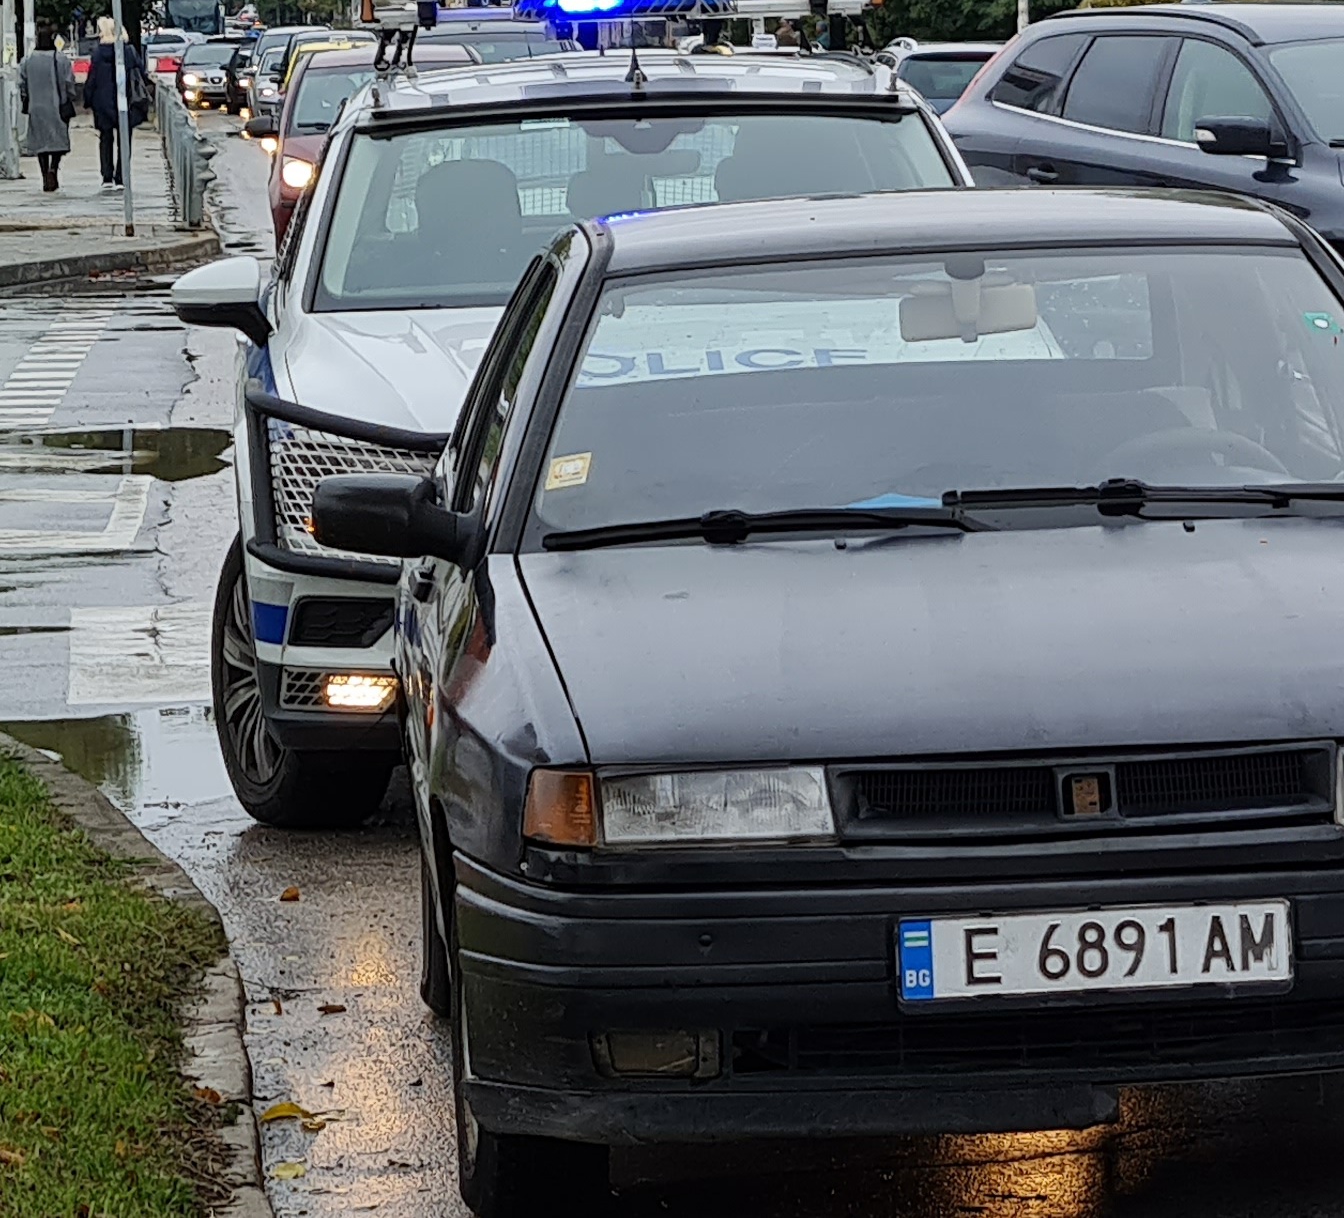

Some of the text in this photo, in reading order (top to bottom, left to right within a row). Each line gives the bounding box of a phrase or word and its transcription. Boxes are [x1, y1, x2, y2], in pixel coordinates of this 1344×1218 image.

[579, 348, 867, 379] OLICE
[905, 913, 1277, 988] BG E 6891 AM
